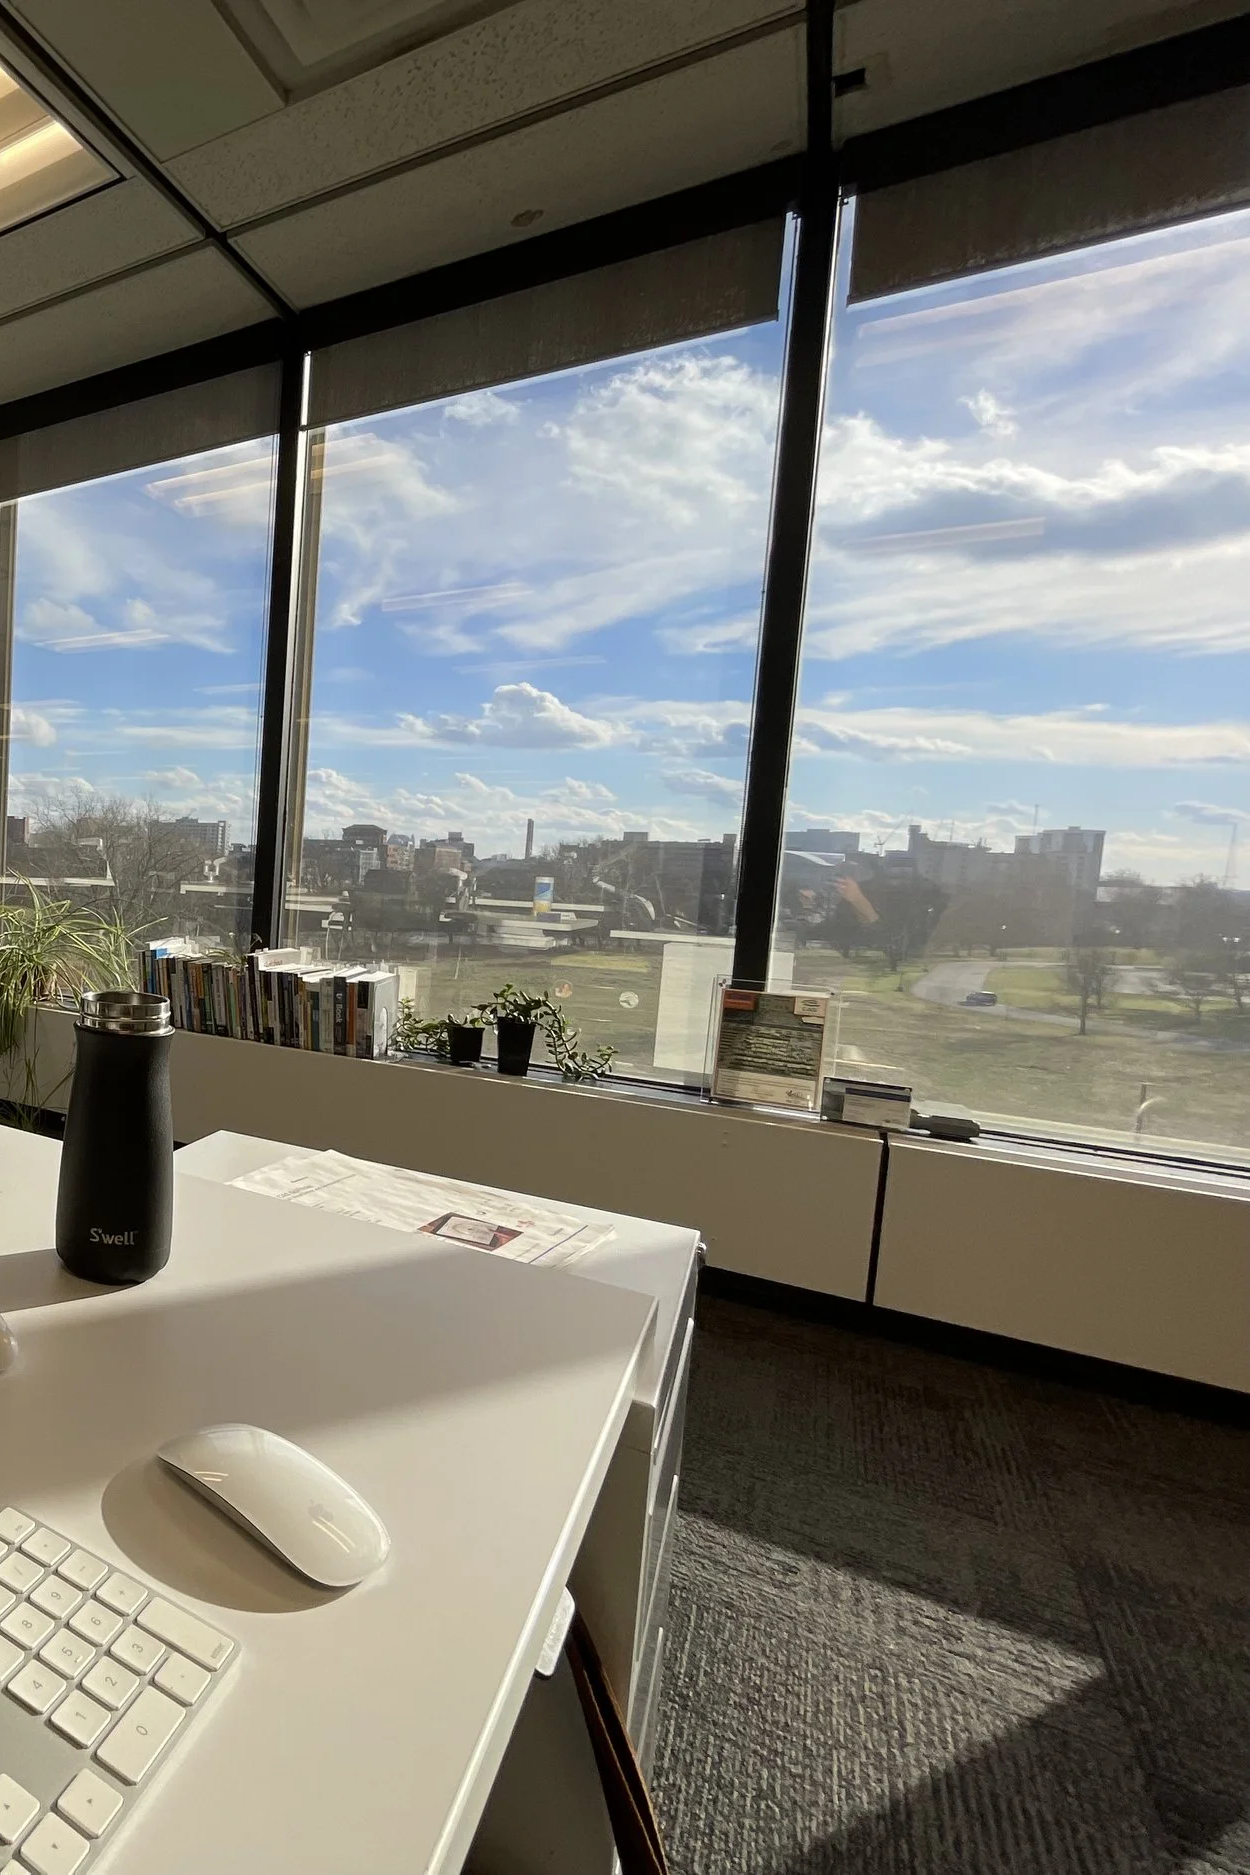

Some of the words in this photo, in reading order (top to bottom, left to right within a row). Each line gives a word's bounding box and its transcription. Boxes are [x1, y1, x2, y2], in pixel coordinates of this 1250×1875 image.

[90, 1227, 135, 1246] S'well
[51, 1591, 62, 1600] 9
[21, 1619, 33, 1629] 8
[90, 1616, 101, 1626] 6
[61, 1646, 73, 1657] 5
[131, 1643, 144, 1653] 3
[32, 1679, 44, 1690] 4
[104, 1676, 118, 1687] 2
[75, 1711, 87, 1721] 1
[135, 1725, 148, 1736] 0
